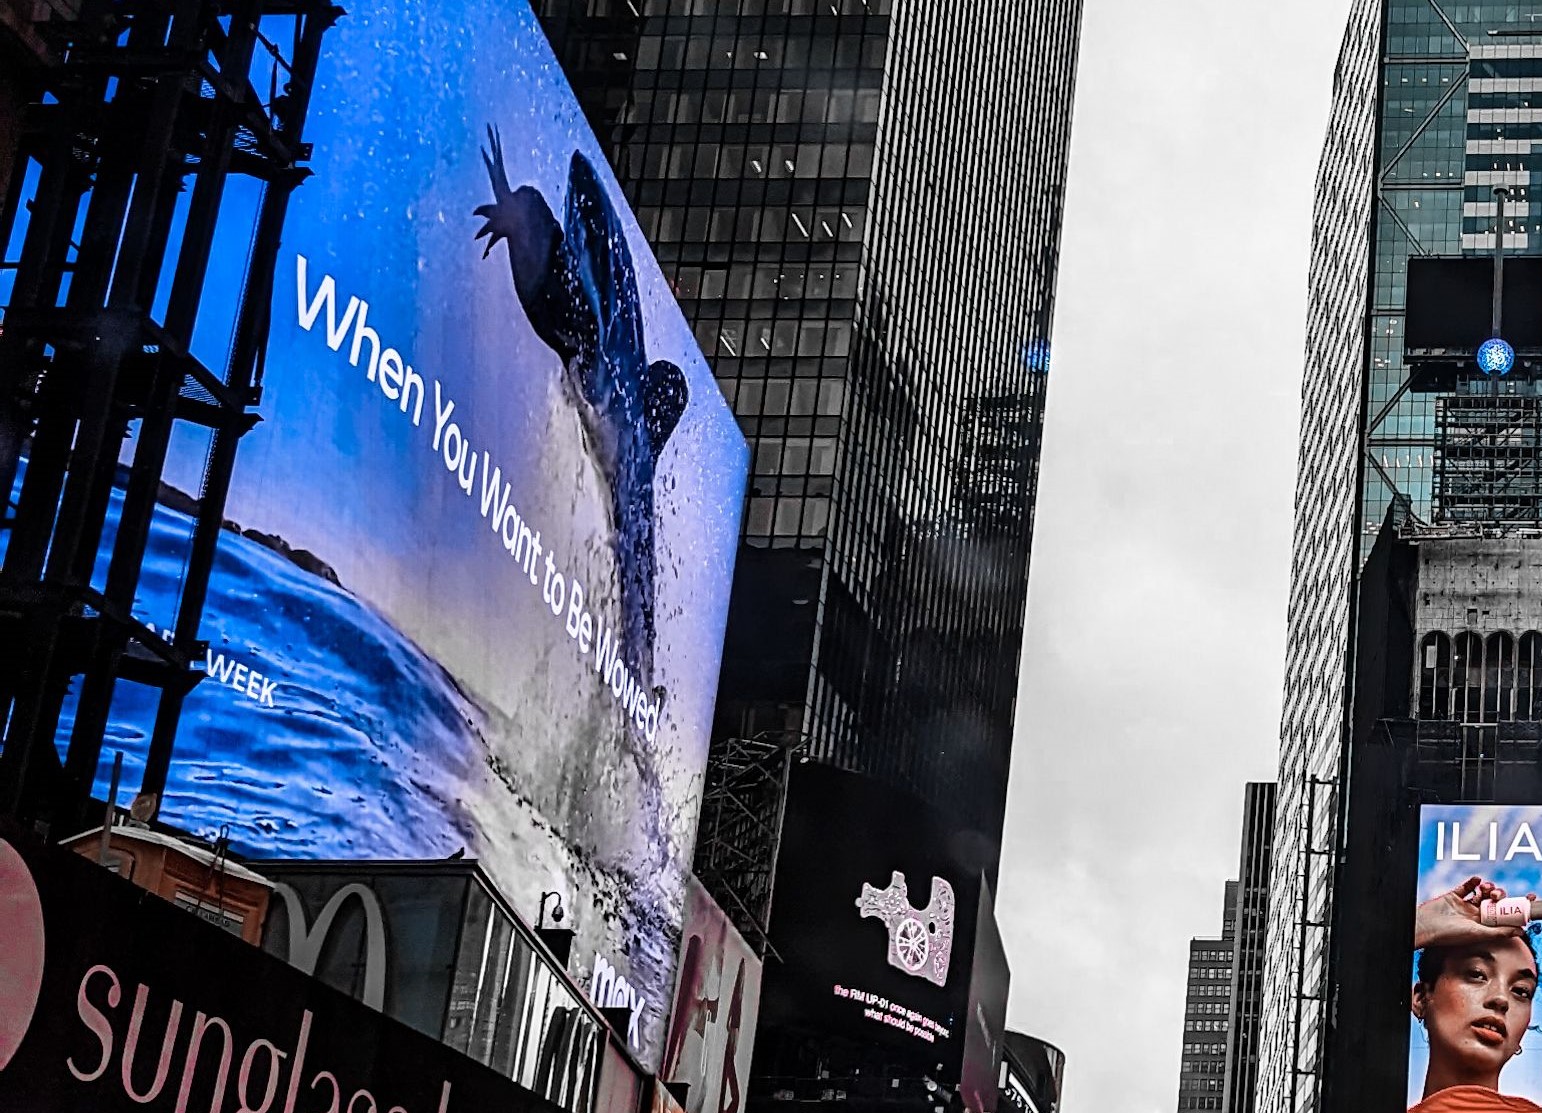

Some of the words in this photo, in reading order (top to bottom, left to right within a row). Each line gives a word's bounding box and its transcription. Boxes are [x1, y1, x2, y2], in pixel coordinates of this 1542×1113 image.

[297, 253, 426, 427] When
[431, 380, 478, 496] You
[479, 451, 544, 586] Want
[543, 550, 568, 616] to
[565, 579, 593, 655] Be
[594, 615, 662, 746] Wowed
[206, 648, 278, 708] WEEK
[1500, 906, 1522, 916] ILIA
